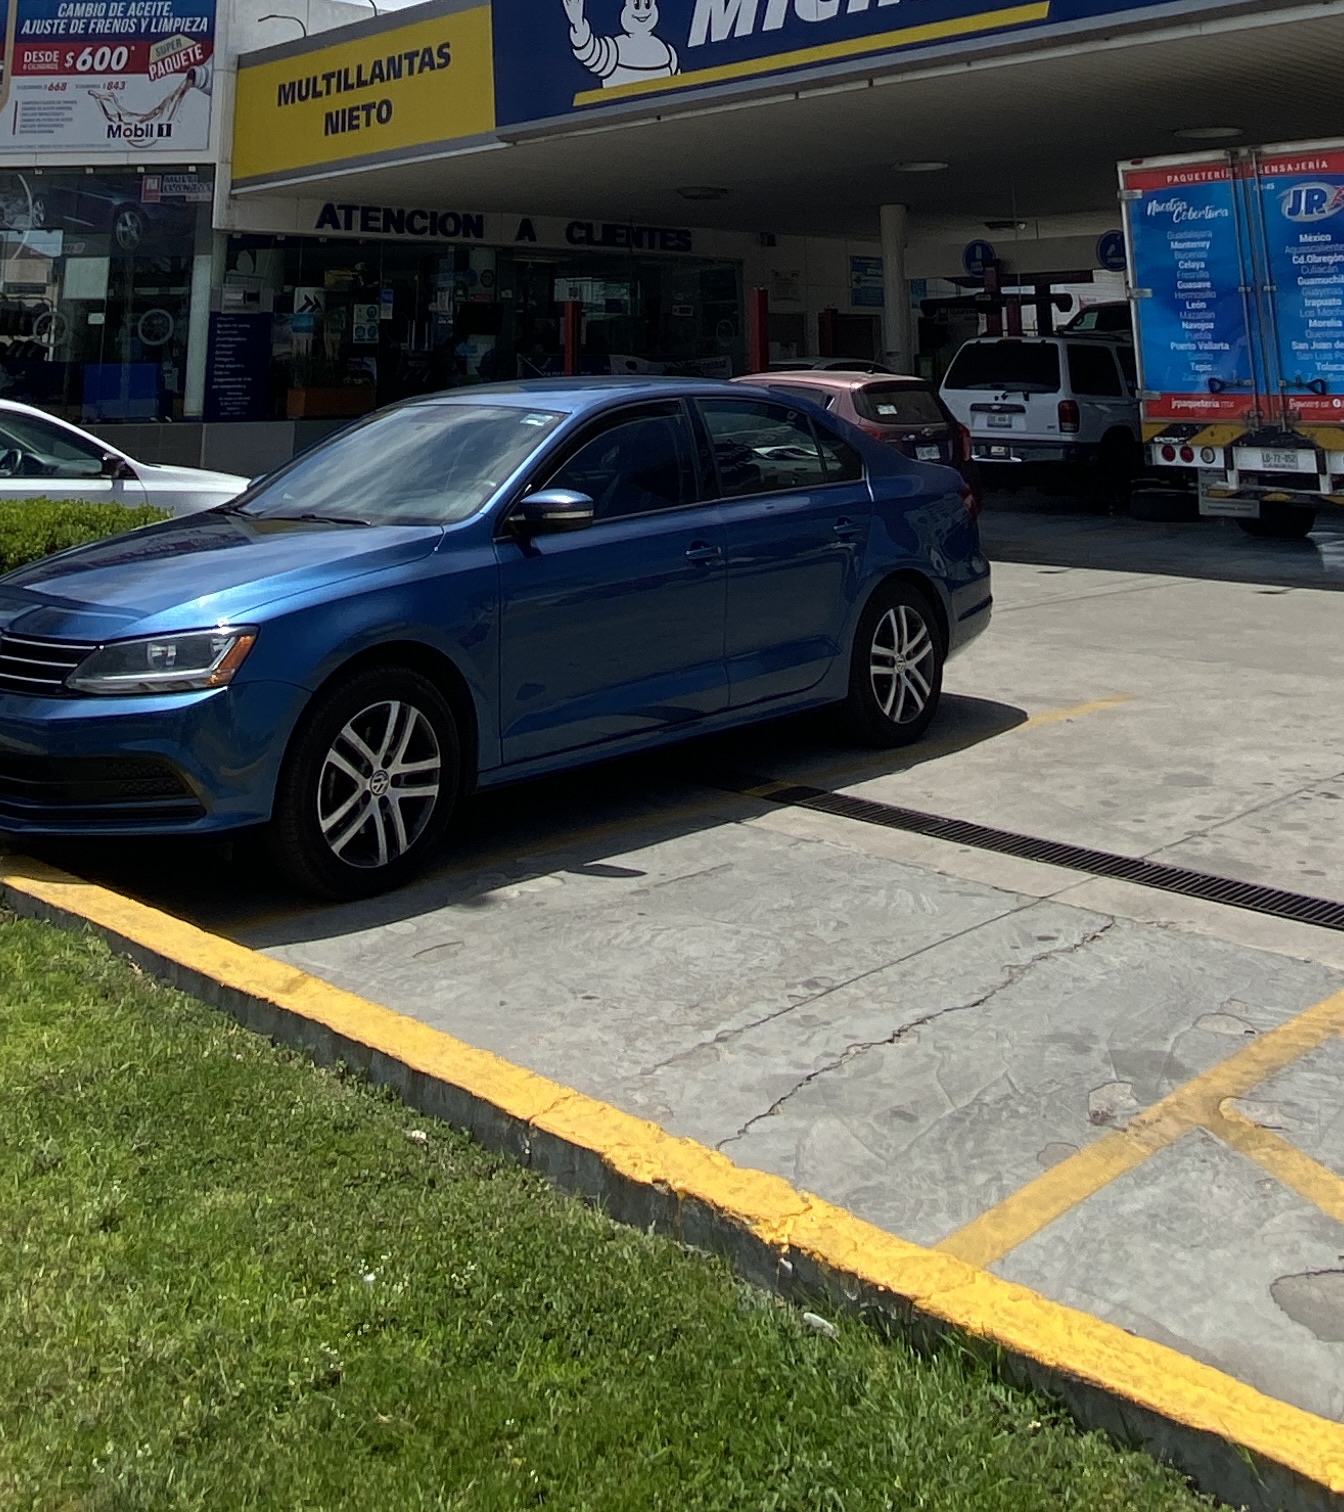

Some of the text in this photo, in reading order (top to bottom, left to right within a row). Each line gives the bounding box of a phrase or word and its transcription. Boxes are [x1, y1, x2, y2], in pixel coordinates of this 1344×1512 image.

[57, 2, 105, 19] CAMBIO
[109, 1, 124, 18] DE
[20, 17, 209, 36] AJUSTE DE FRENOS Y LIMPIEZA
[24, 50, 59, 63] DESDE
[149, 44, 204, 80] PAQUETE
[277, 42, 452, 107] MULTILLANTAS
[324, 98, 393, 137] NIETO
[106, 124, 154, 138] Mobil
[315, 202, 692, 252] ATENCION A CLIENTES
[1299, 232, 1331, 242] México
[1171, 241, 1210, 250] Monterrey
[1179, 261, 1205, 270] Celaya
[1177, 281, 1211, 289] Guasave
[1186, 301, 1206, 309] León
[1305, 298, 1342, 307] Irapuato
[1300, 309, 1315, 317] Los
[1182, 321, 1214, 331] Navojoa
[1309, 319, 1342, 327] Morelia
[1171, 341, 1230, 350] Puerto Vallarta
[1292, 341, 1309, 350] San
[1311, 340, 1332, 349] Juan
[1316, 362, 1344, 371] Toluca
